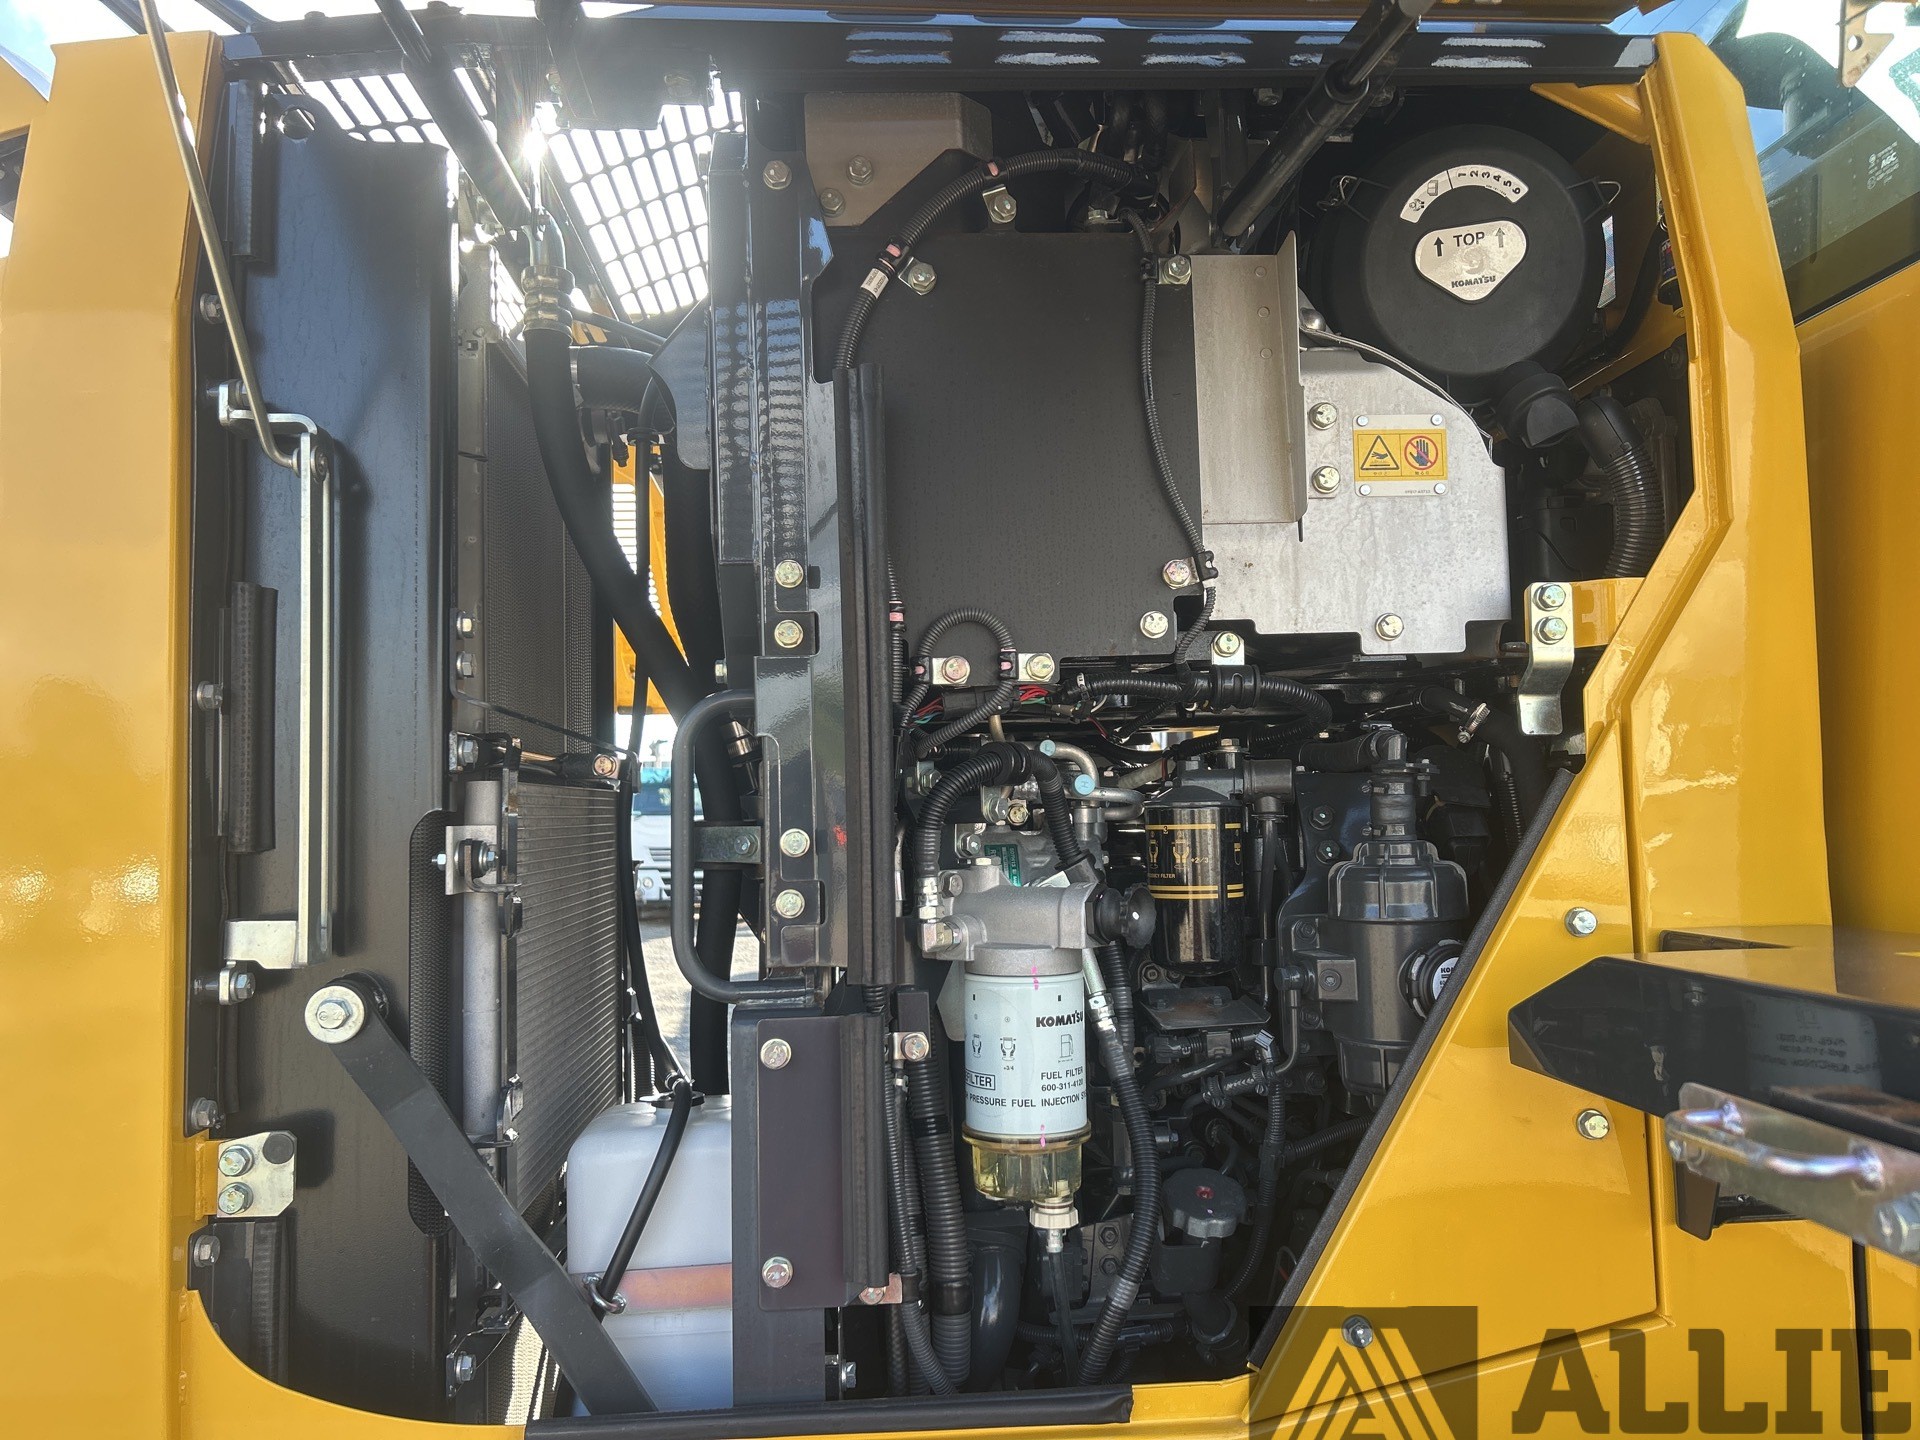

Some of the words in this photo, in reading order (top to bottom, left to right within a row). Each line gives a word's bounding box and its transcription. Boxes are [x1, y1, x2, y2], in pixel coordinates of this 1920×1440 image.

[1482, 171, 1490, 179] 3
[1493, 174, 1501, 182] 4
[1512, 187, 1521, 195] 6
[1453, 231, 1485, 247] TOP
[1451, 275, 1496, 288] KOMATSU
[1035, 1010, 1083, 1028] KOMATSU
[1040, 1070, 1063, 1081] FUEL
[1065, 1066, 1083, 1078] FILTER
[969, 1092, 1007, 1107] PRESSURE
[1011, 1098, 1037, 1108] FUEL
[1041, 1092, 1080, 1107] INJECTION
